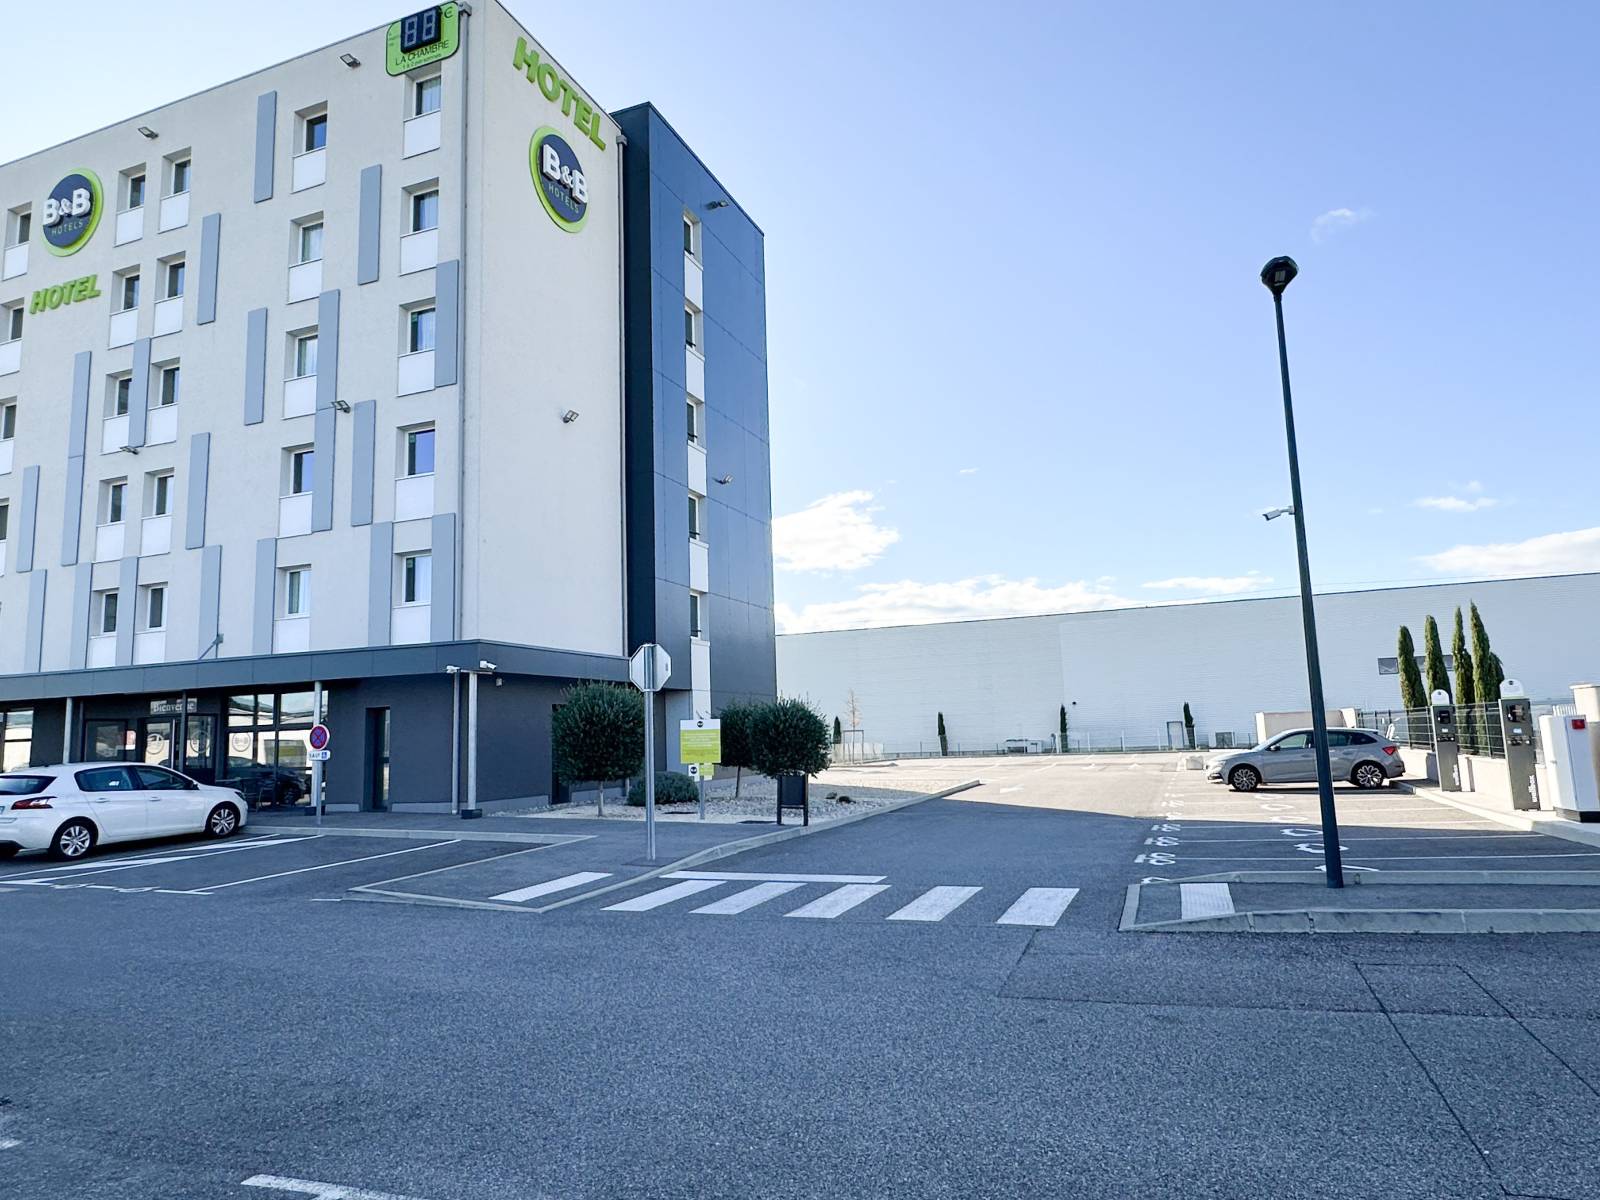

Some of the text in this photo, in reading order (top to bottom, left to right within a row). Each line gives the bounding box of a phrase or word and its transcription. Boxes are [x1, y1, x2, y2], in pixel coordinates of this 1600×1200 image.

[395, 56, 406, 65] LA
[407, 40, 449, 61] CHAMBRE
[512, 36, 606, 152] HOTEL
[542, 143, 589, 204] B&B
[42, 187, 92, 226] B&B
[548, 183, 580, 214] HOTELS
[51, 220, 84, 236] HOTELS
[29, 274, 101, 314] HOTEL
